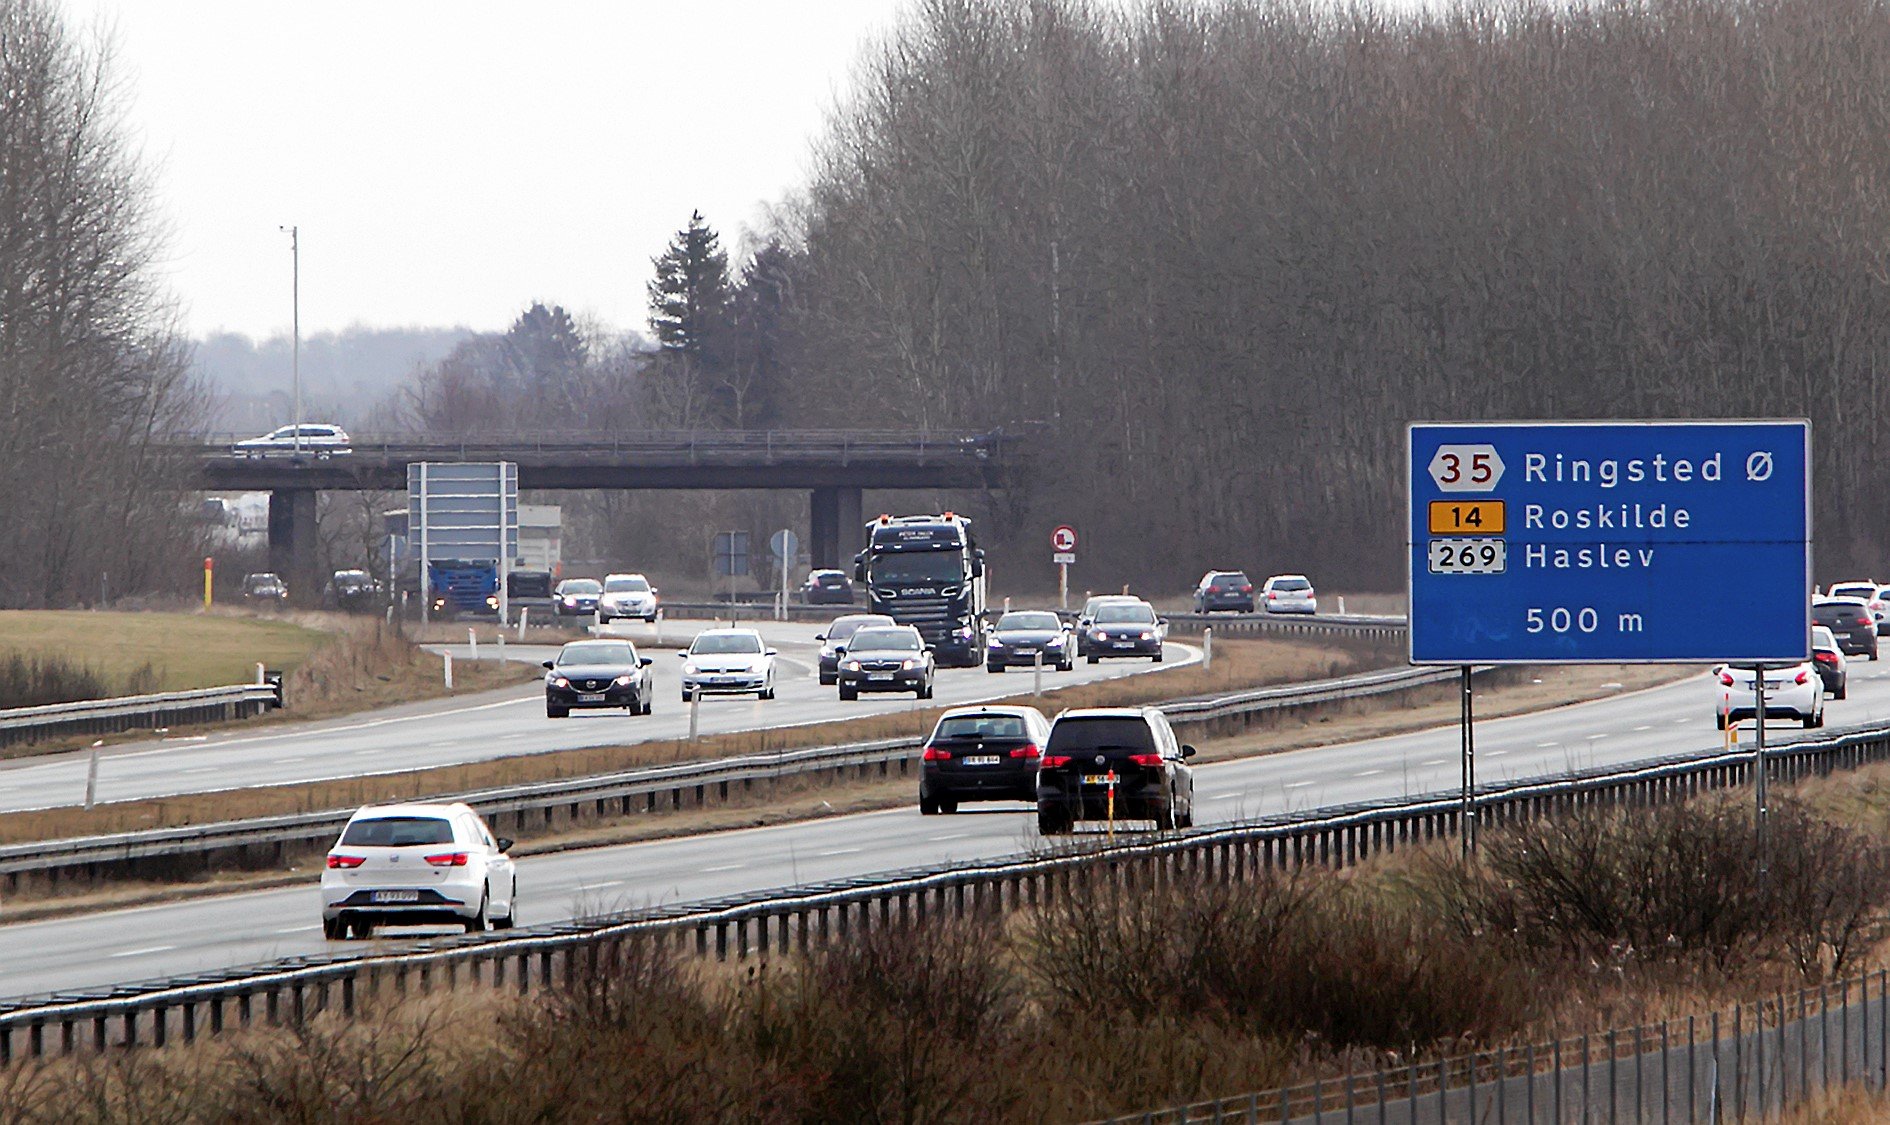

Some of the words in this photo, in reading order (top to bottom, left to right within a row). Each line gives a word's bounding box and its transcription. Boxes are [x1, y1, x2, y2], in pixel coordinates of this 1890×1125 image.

[1440, 453, 1493, 483] 35
[1525, 452, 1722, 488] Ringsted
[1746, 451, 1774, 481] Ø
[1451, 506, 1483, 528] 14
[1525, 503, 1691, 529] Roskilde
[1439, 545, 1496, 567] 269
[1525, 543, 1655, 568] Haslev
[1525, 607, 1599, 633] 500
[1618, 613, 1644, 632] m
